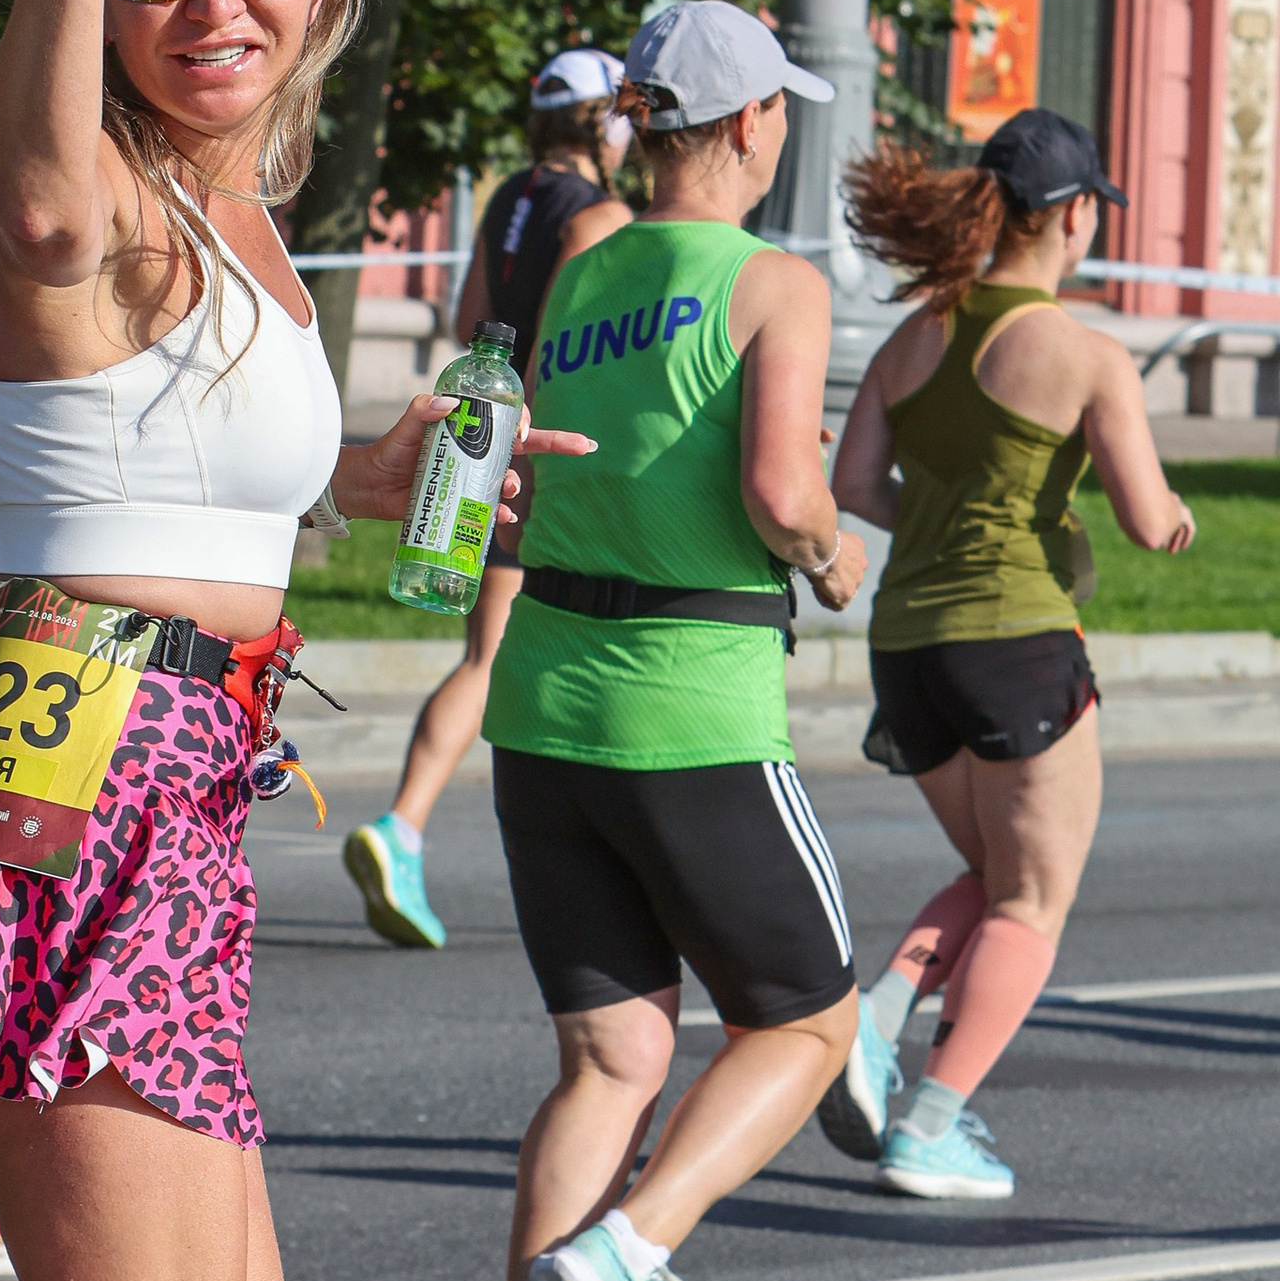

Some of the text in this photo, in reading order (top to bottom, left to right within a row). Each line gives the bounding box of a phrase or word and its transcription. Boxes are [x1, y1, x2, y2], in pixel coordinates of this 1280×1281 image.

[536, 296, 702, 384] RUNUP
[414, 431, 449, 545] FAHRENHEIT
[426, 456, 456, 547] ISOTONIC
[436, 460, 462, 549] ELECTROLYTE DRINK
[456, 524, 483, 537] KIWI
[28, 609, 78, 628] 24.08.2025
